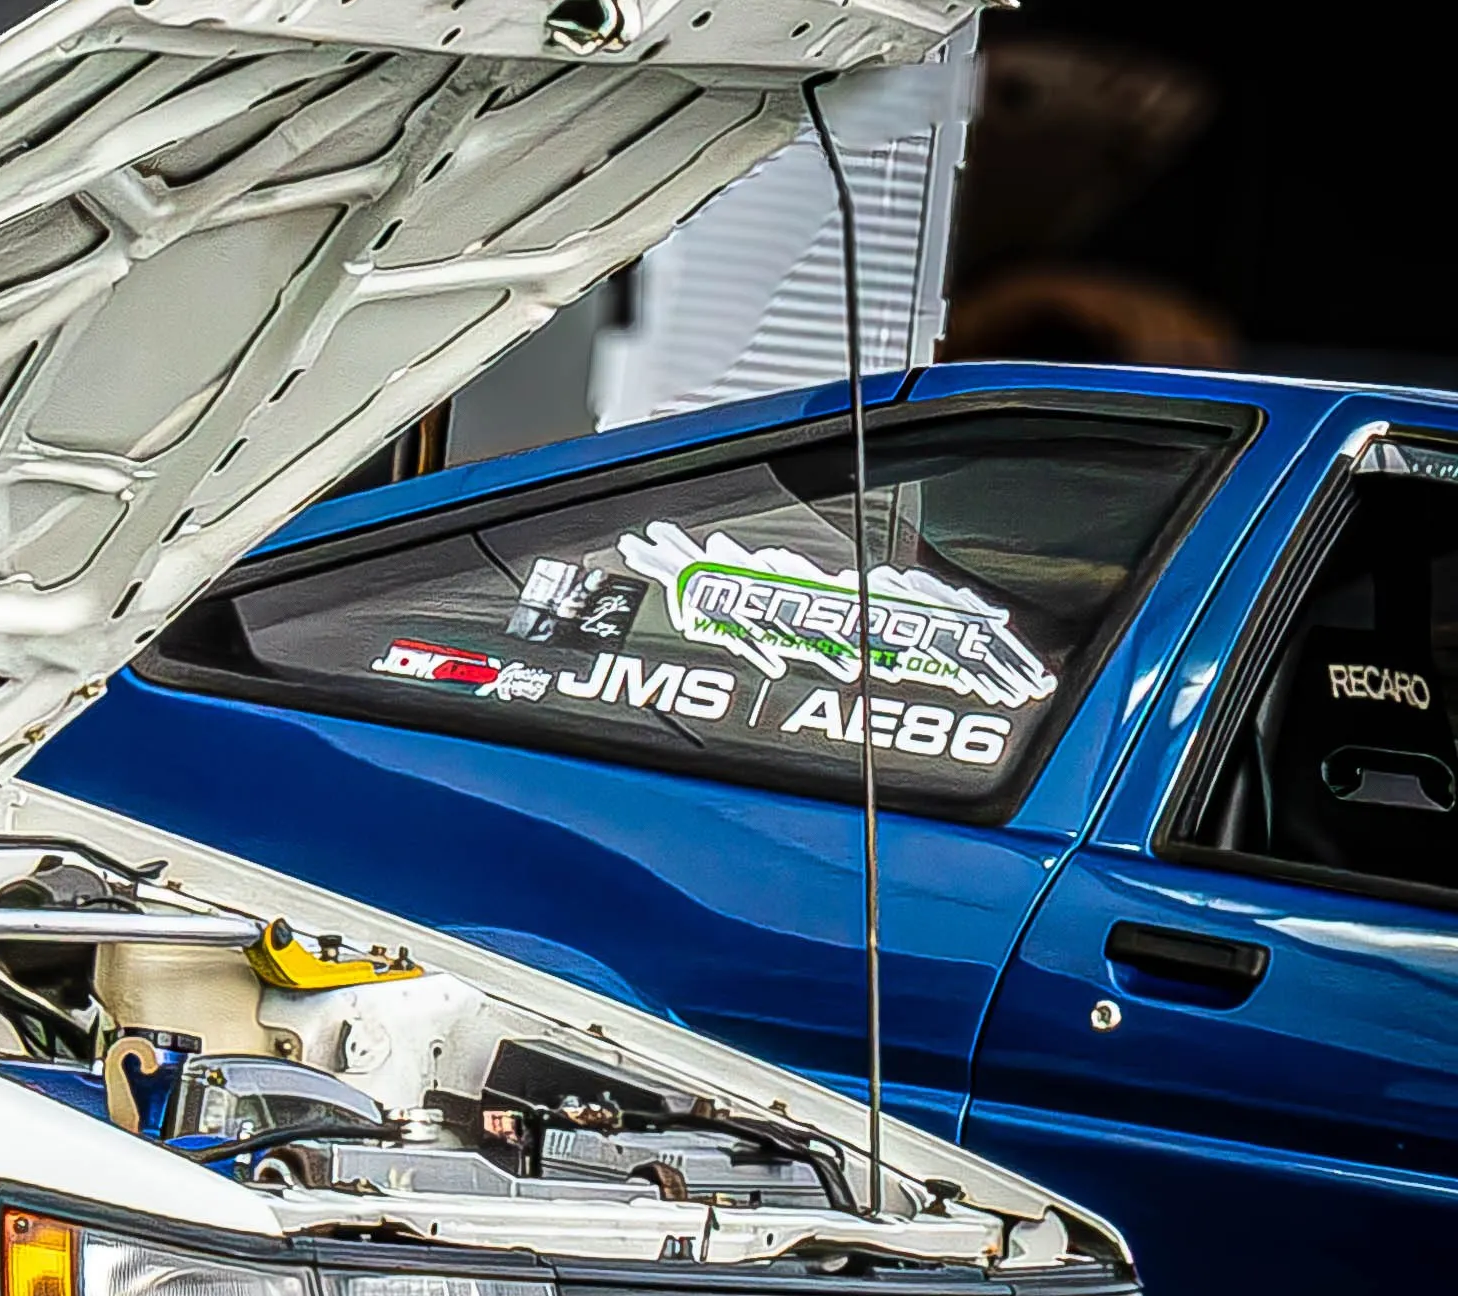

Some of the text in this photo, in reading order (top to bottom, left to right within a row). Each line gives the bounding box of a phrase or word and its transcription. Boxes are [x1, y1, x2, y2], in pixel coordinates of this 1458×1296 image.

[557, 652, 734, 721] JMS
[780, 688, 1014, 765] AE86
[1328, 664, 1430, 710] RECARO
